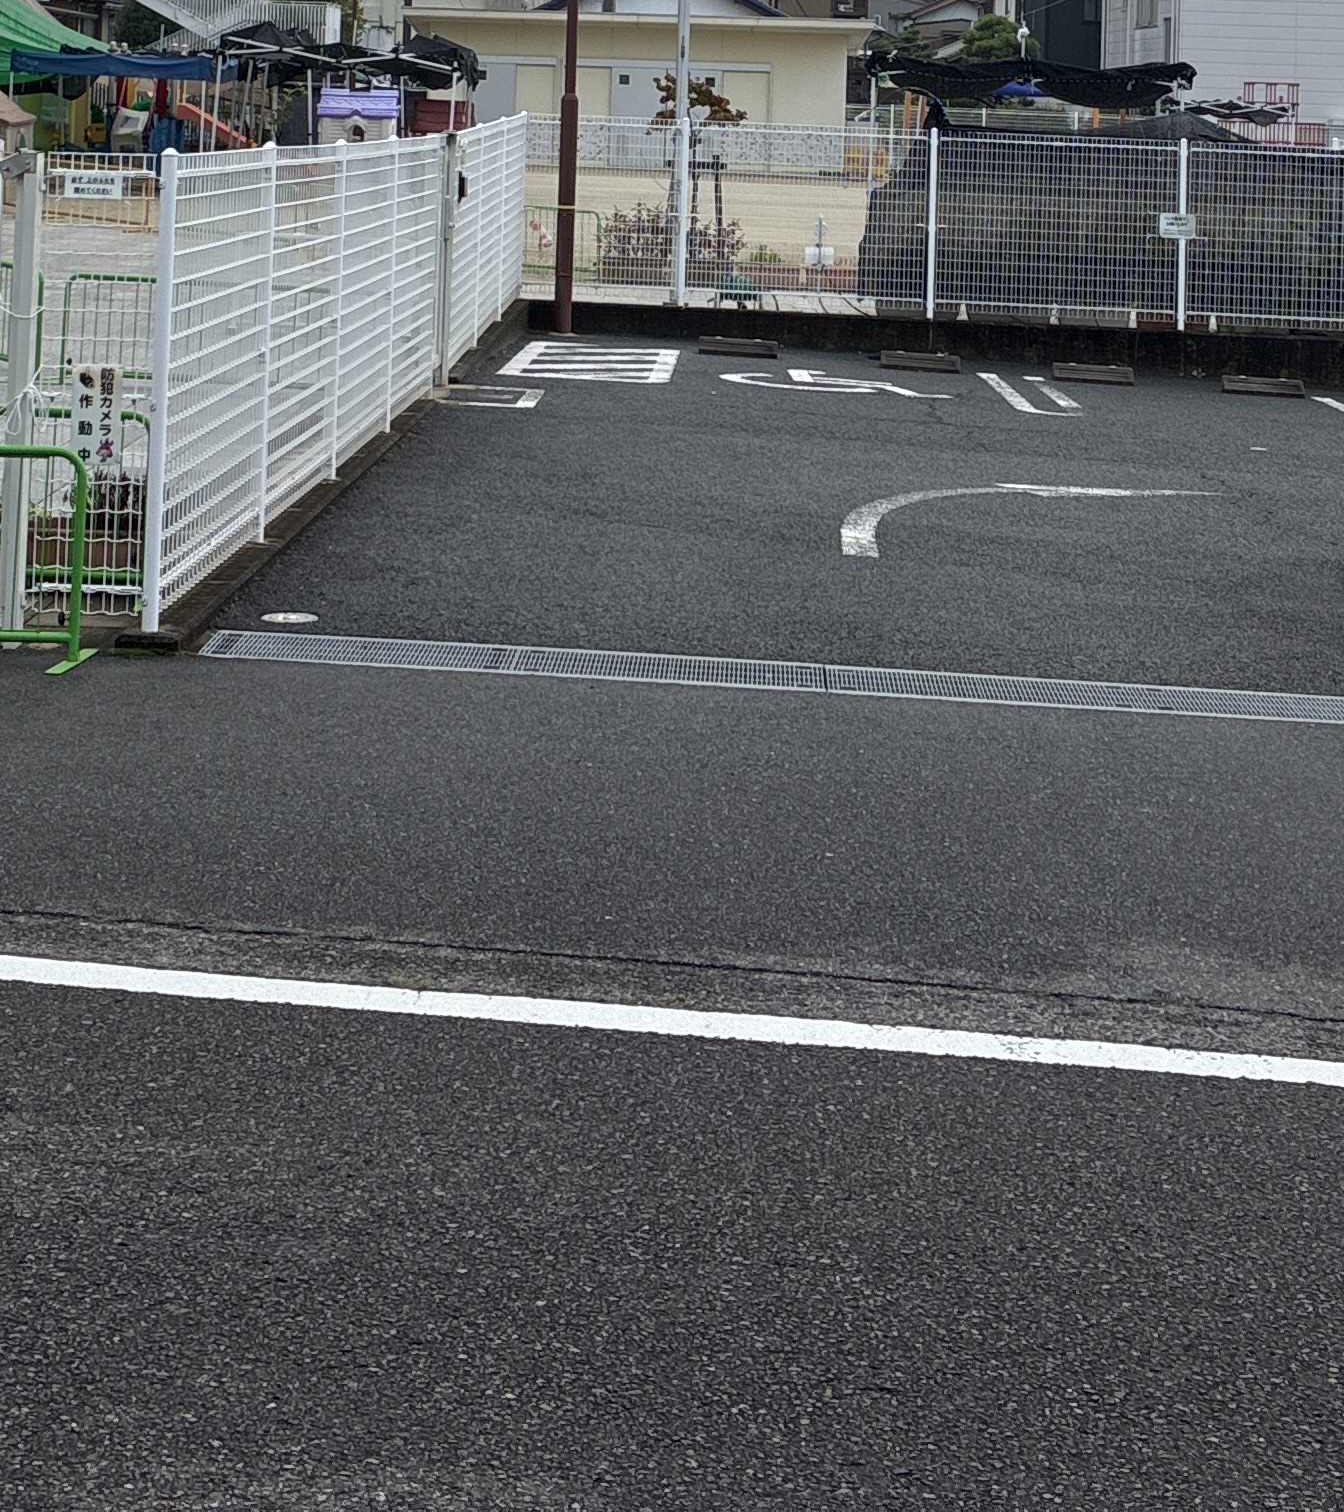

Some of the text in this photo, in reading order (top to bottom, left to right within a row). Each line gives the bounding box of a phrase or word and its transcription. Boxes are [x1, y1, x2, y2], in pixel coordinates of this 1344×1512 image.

[77, 393, 94, 462] 作動中
[99, 367, 116, 437] 防犯カメラ
